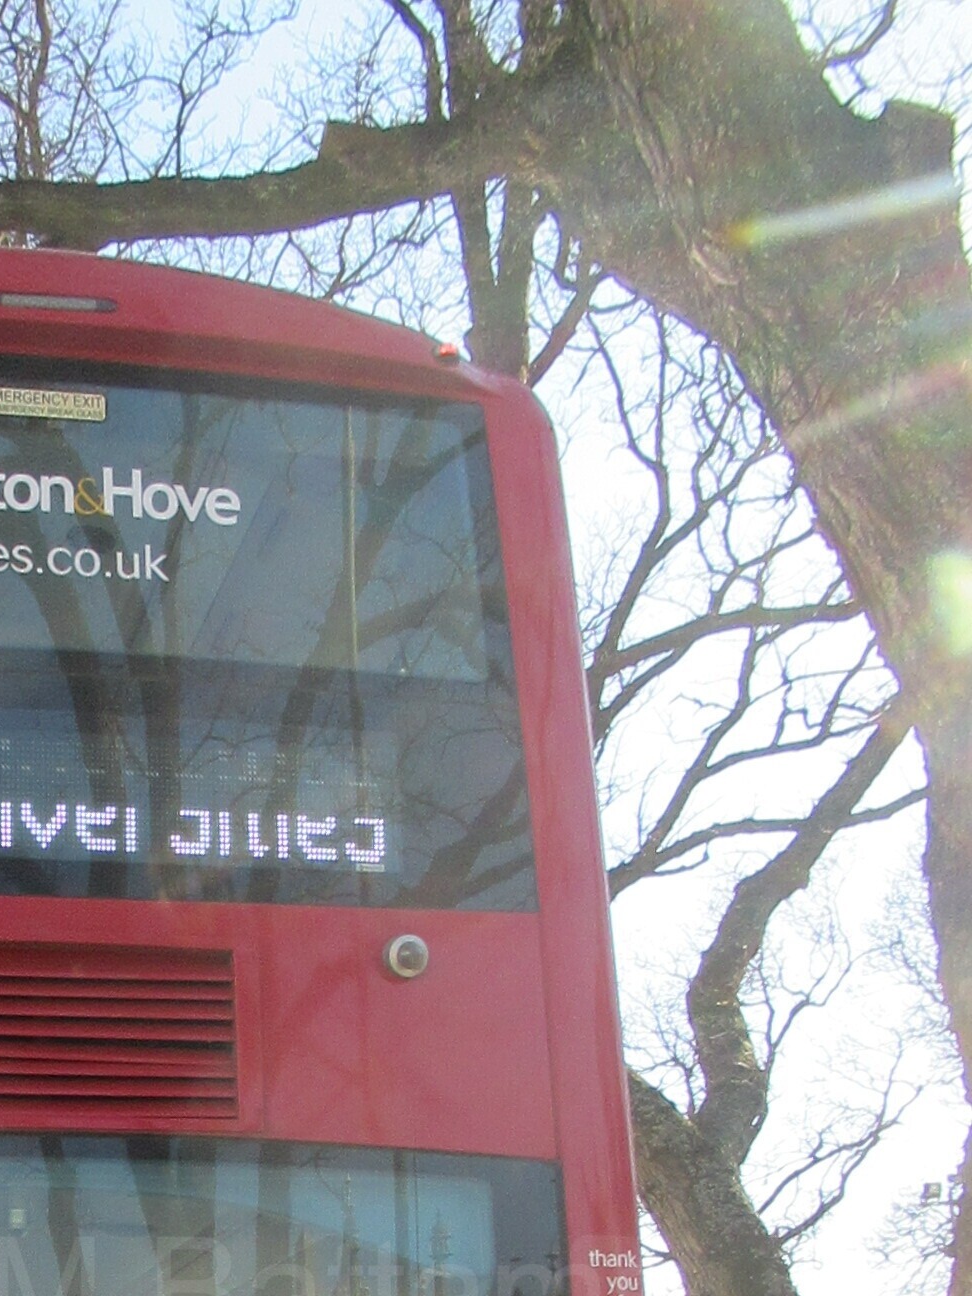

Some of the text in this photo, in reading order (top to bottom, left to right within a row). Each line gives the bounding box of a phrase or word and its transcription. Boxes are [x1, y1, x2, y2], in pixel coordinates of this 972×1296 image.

[73, 394, 103, 408] EXIT
[588, 1249, 638, 1268] thank
[606, 1276, 639, 1295] you
